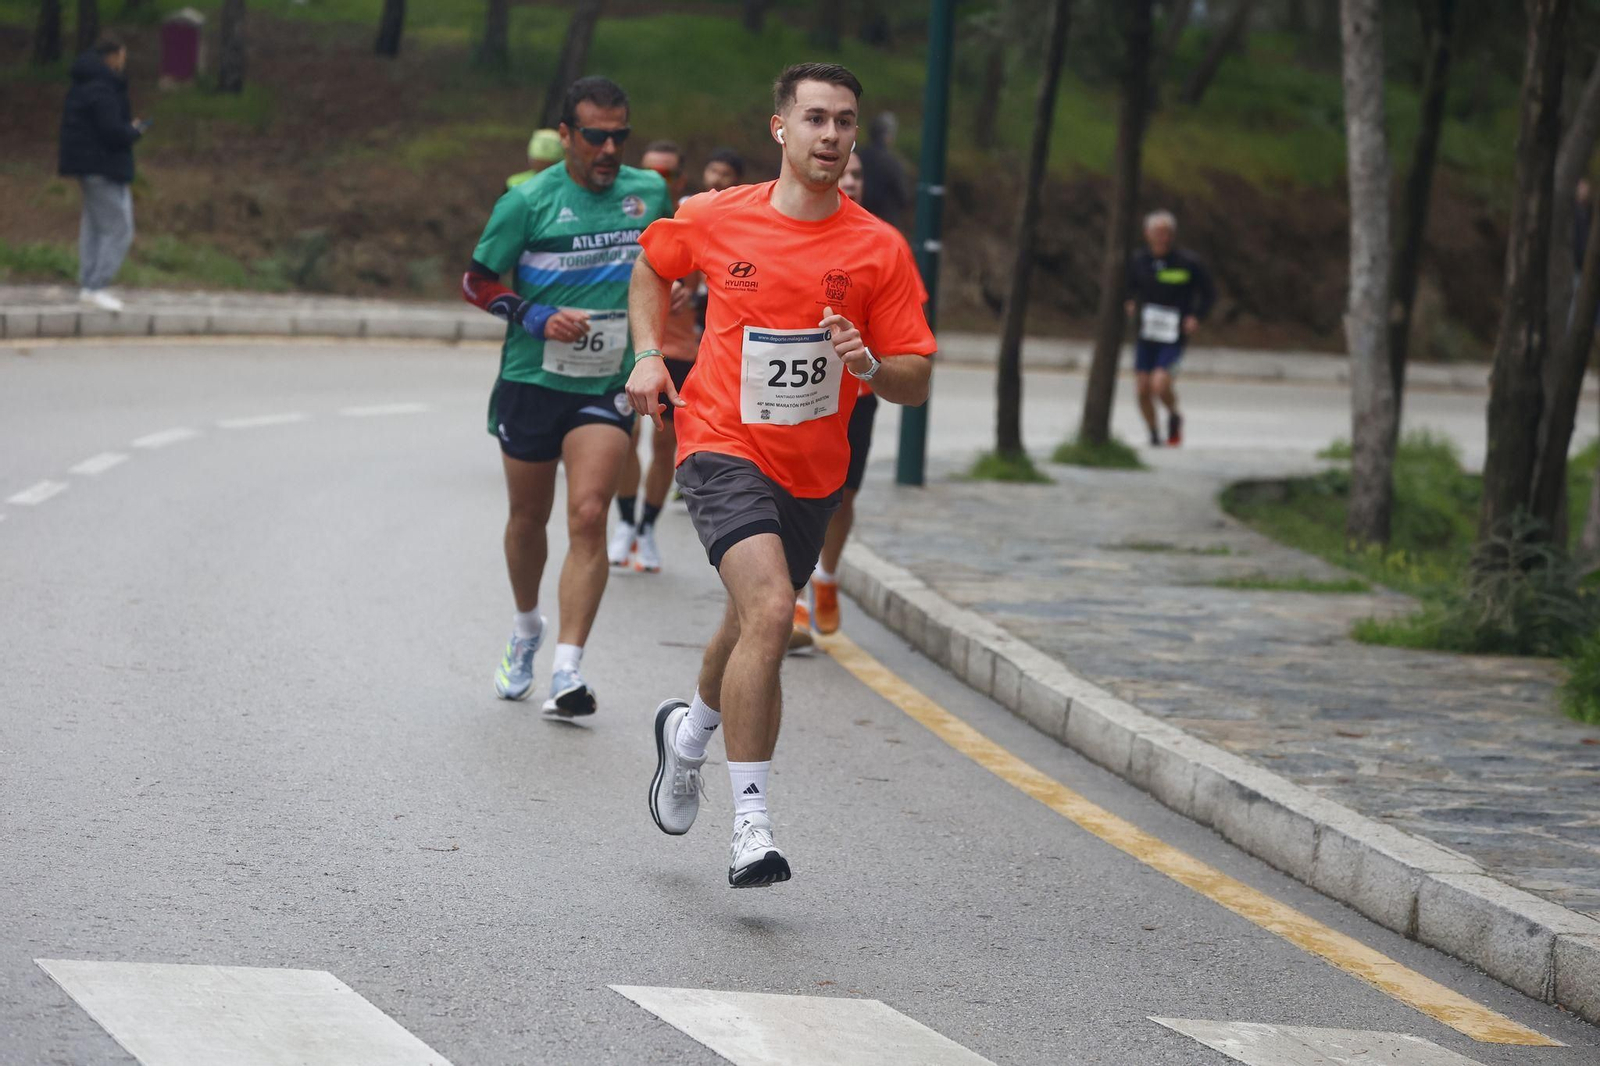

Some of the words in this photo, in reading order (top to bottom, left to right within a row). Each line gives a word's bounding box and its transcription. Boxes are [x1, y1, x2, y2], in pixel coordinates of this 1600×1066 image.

[725, 279, 759, 288] HYUNDAI
[573, 331, 604, 352] 96
[767, 356, 828, 388] 258
